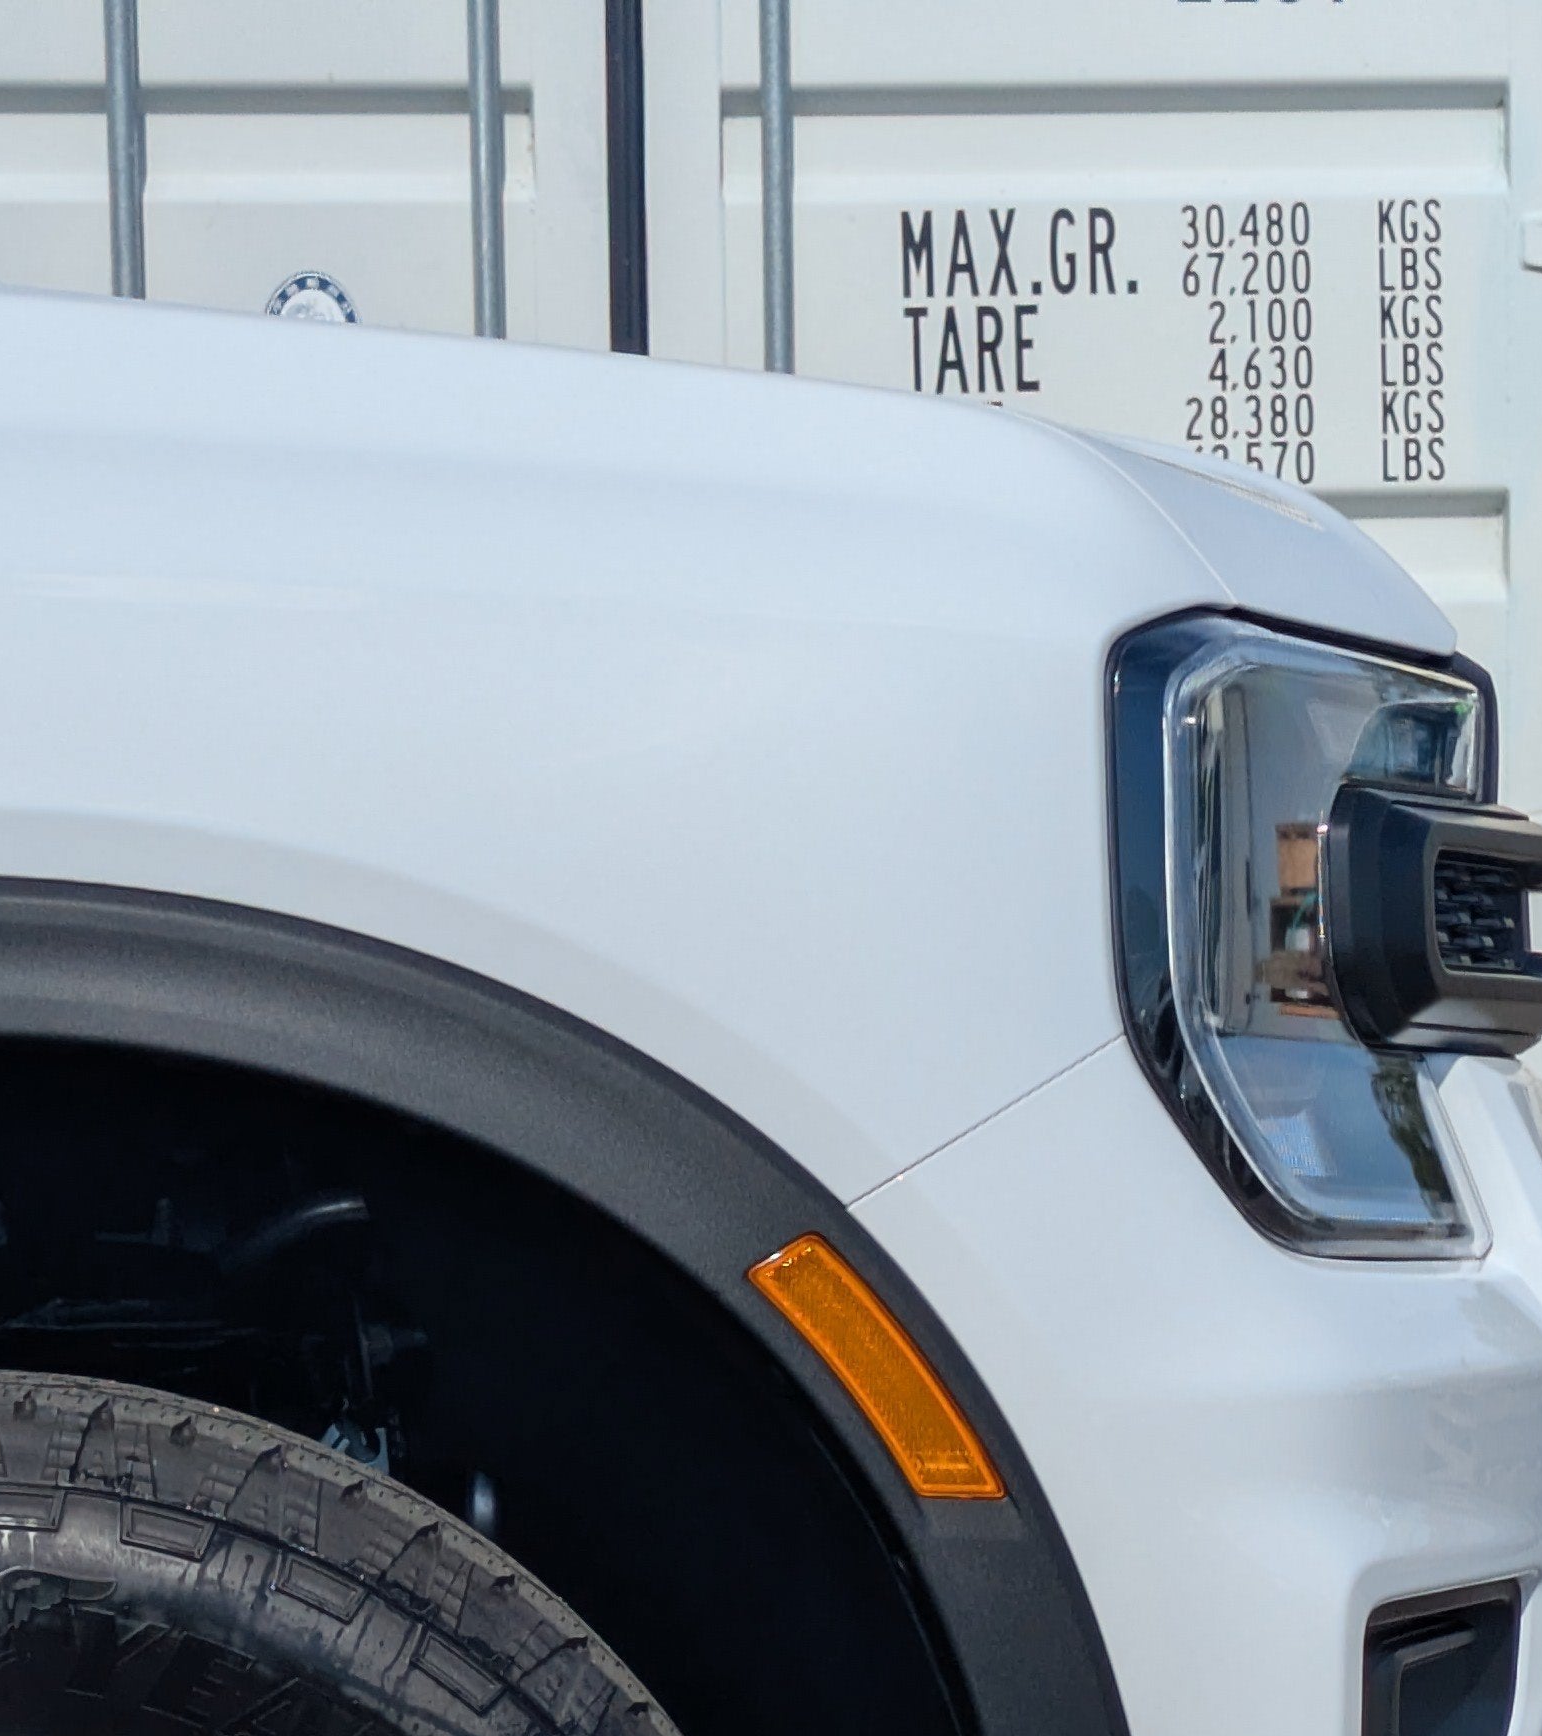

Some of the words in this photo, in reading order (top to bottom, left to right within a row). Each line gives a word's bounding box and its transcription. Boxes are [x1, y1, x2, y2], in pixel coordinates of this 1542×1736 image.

[1378, 199, 1441, 244] KGS
[900, 207, 1139, 298] MAX.GR.
[1378, 247, 1442, 291] LBS
[1380, 295, 1443, 339] KGS
[903, 304, 1040, 395] TARE
[1380, 342, 1444, 387] LBS
[1381, 389, 1444, 435] KGS
[1382, 437, 1445, 483] LBS
